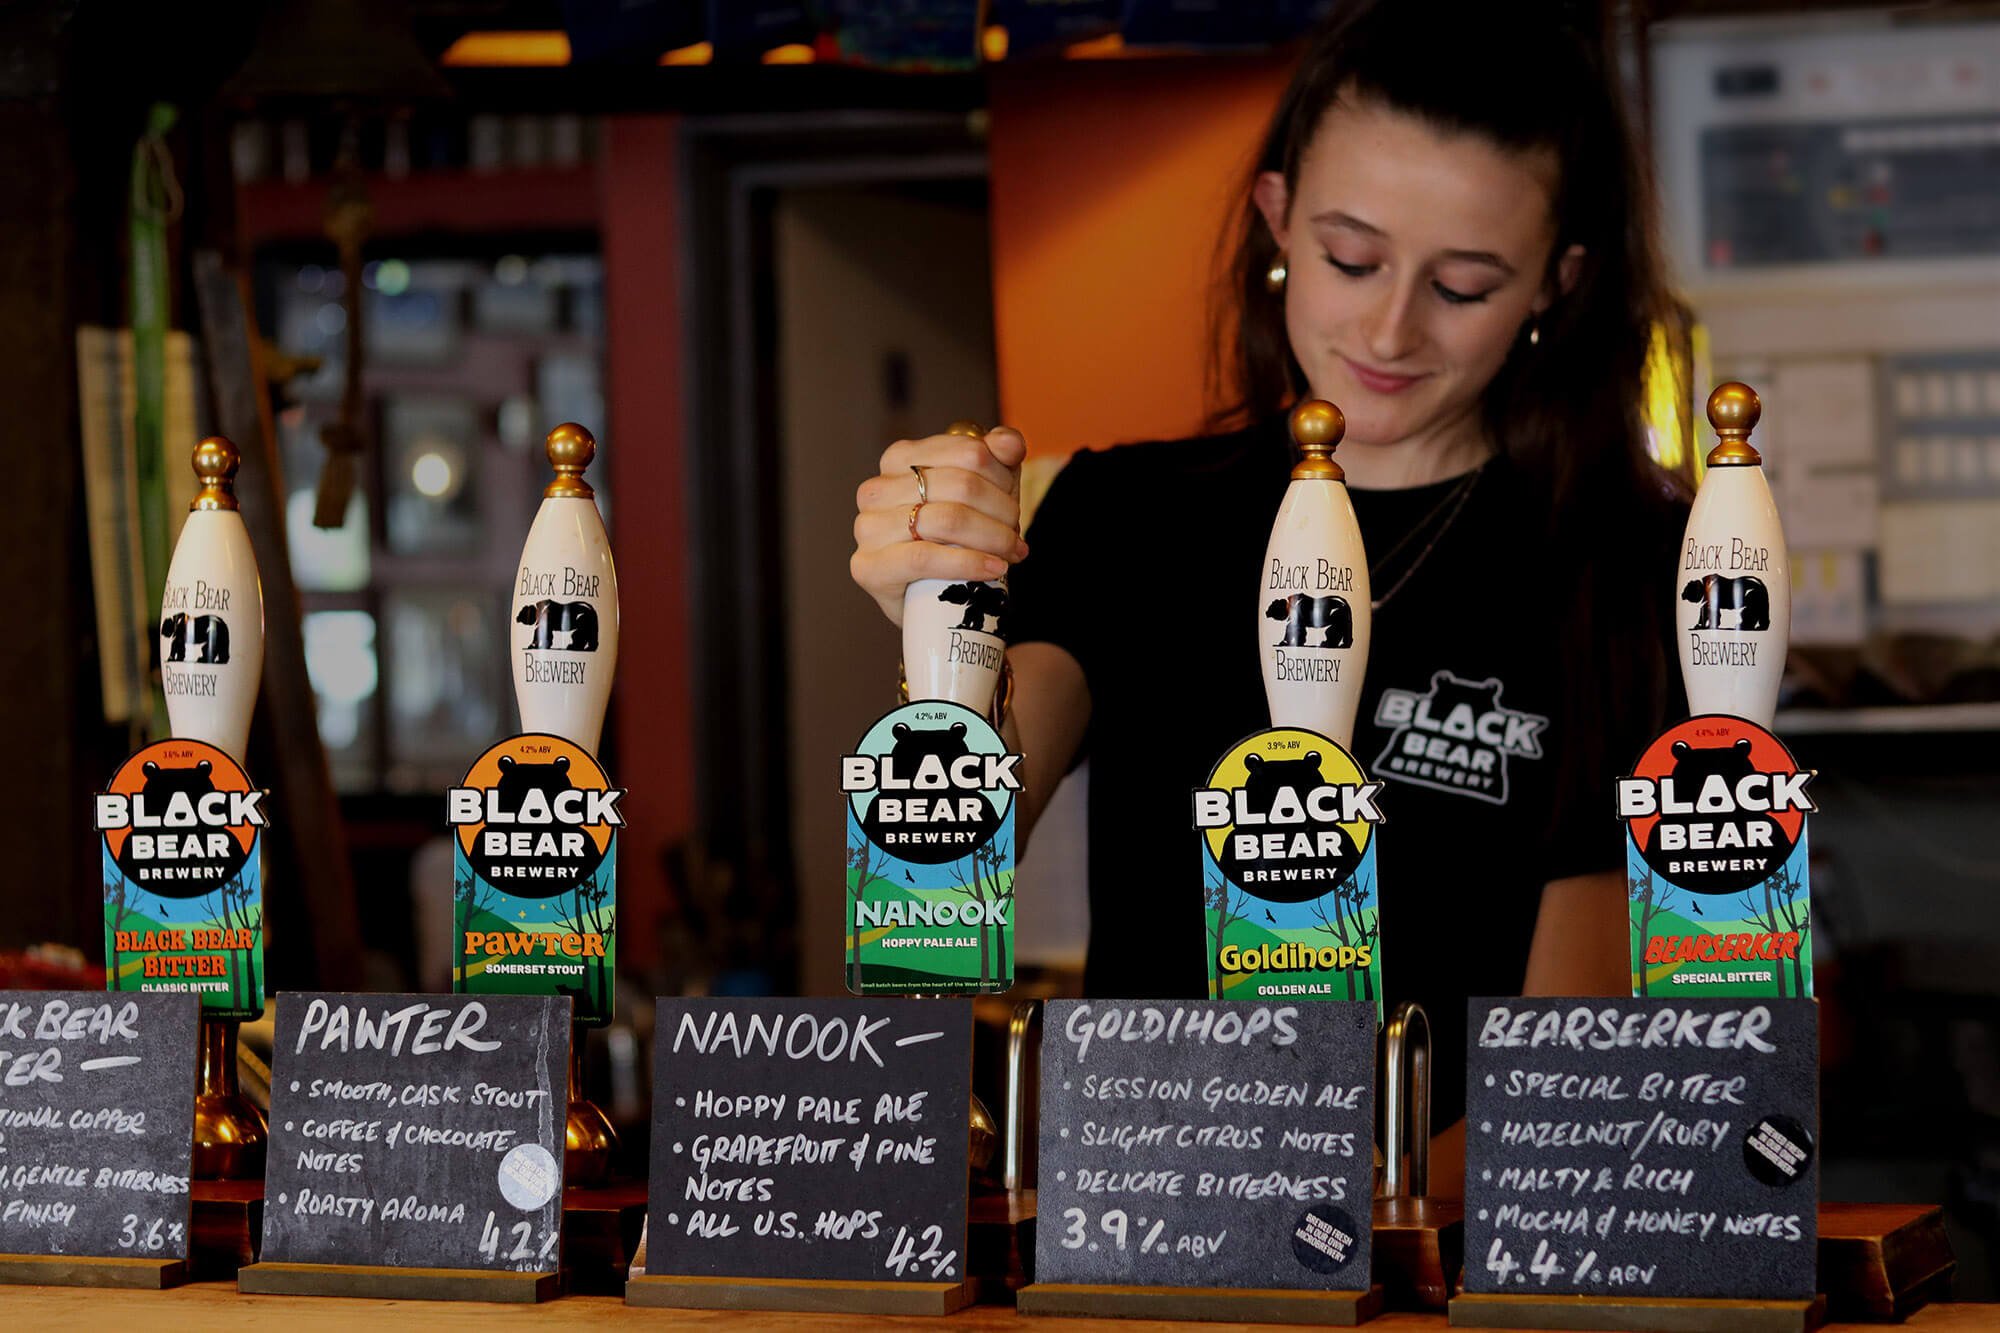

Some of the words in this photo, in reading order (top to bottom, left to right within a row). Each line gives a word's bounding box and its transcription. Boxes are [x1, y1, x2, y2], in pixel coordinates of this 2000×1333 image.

[166, 665, 217, 696] BREWERY
[934, 712, 947, 720] ABV
[1381, 694, 1539, 752] BLACK
[539, 745, 551, 753] ABV
[1267, 742, 1286, 750] 3.9%
[1287, 741, 1300, 749] ABV
[1402, 732, 1496, 773] BEAR
[842, 753, 1020, 790] BLACK
[1390, 756, 1494, 789] BREWERY
[96, 791, 264, 829] BLACK
[450, 788, 622, 824] BLACK
[1195, 783, 1382, 827] BLACK
[1619, 773, 1812, 817] BLACK
[878, 798, 983, 823] BEAR
[131, 833, 230, 860] BEAR
[484, 831, 585, 857] BEAR
[885, 832, 977, 844] BREWERY
[1234, 831, 1343, 860] BEAR
[1659, 820, 1773, 851] BEAR
[139, 866, 225, 880] BREWERY
[491, 866, 579, 878] BREWERY
[1243, 867, 1337, 882] BREWERY
[1669, 858, 1768, 873] BREWERY
[855, 899, 1008, 929] NANOOK
[115, 929, 187, 952] BLACK
[192, 927, 254, 951] BEAR
[881, 938, 921, 948] HOPPY
[923, 938, 953, 948] PALE
[955, 937, 978, 948] ALE
[1645, 931, 1800, 964] BEARSERKER
[143, 955, 227, 978] BITTER
[485, 964, 547, 975] SOMERSET
[547, 964, 585, 975] STOUT
[1218, 941, 1373, 973] Goldihops
[141, 982, 188, 993] CLASSIC
[190, 982, 229, 993] BITTER
[1258, 985, 1309, 996] GOLDEN
[1309, 984, 1331, 994] ALE
[1672, 972, 1725, 984] SPECIAL
[1727, 971, 1772, 983] BITTER
[34, 1000, 139, 1044] BEAR
[296, 998, 502, 1057] PAWTER
[1065, 1004, 1299, 1063] GOLDIHOPS
[1479, 1006, 1777, 1053] BEARSERKER
[673, 1011, 891, 1068] NANOOK
[401, 1084, 461, 1108] CASK
[471, 1083, 549, 1110] STOUT
[1081, 1074, 1193, 1101] SESSION
[1201, 1076, 1308, 1112] GOLDEN
[1315, 1084, 1366, 1110] ALE
[1505, 1070, 1629, 1100] SPECIAL
[1637, 1072, 1747, 1105] BITTER
[69, 1108, 146, 1135] COPPER
[694, 1089, 786, 1121] HOPPY
[797, 1096, 862, 1125] PALE
[873, 1091, 928, 1125] ALE
[302, 1119, 381, 1142] COFFEE
[404, 1126, 517, 1152] CHOCOLATE
[1080, 1121, 1174, 1154] SLIGHT
[1176, 1124, 1264, 1151] CITRUS
[1280, 1127, 1355, 1157] NOTES
[297, 1149, 363, 1174] NOTES
[691, 1133, 846, 1174] GRAPEFRUIT
[876, 1135, 937, 1165] PINE
[94, 1167, 190, 1195] BITTERNESS
[685, 1172, 774, 1201] NOTES
[1075, 1168, 1186, 1196] DELICATE
[1196, 1170, 1347, 1201] BITTERNESS
[1499, 1167, 1590, 1197] MALTY
[1623, 1163, 1694, 1195] RICH
[2, 1200, 76, 1227] FINISH
[294, 1188, 374, 1225] ROASTY
[380, 1195, 465, 1224] AROMA
[686, 1209, 740, 1238] ALL
[753, 1210, 804, 1239] U.S.
[814, 1209, 884, 1240] HOPS
[1305, 1223, 1315, 1234] IN
[1313, 1228, 1328, 1242] OUR
[1327, 1236, 1344, 1251] OWN
[1306, 1212, 1334, 1235] BREWED
[1331, 1228, 1353, 1247] FRESH
[1495, 1204, 1589, 1234] MOCHA
[1624, 1207, 1717, 1242] HONEY
[1723, 1212, 1802, 1241] NOTES
[1177, 1230, 1227, 1259] ABV
[1608, 1264, 1657, 1285] ABV
